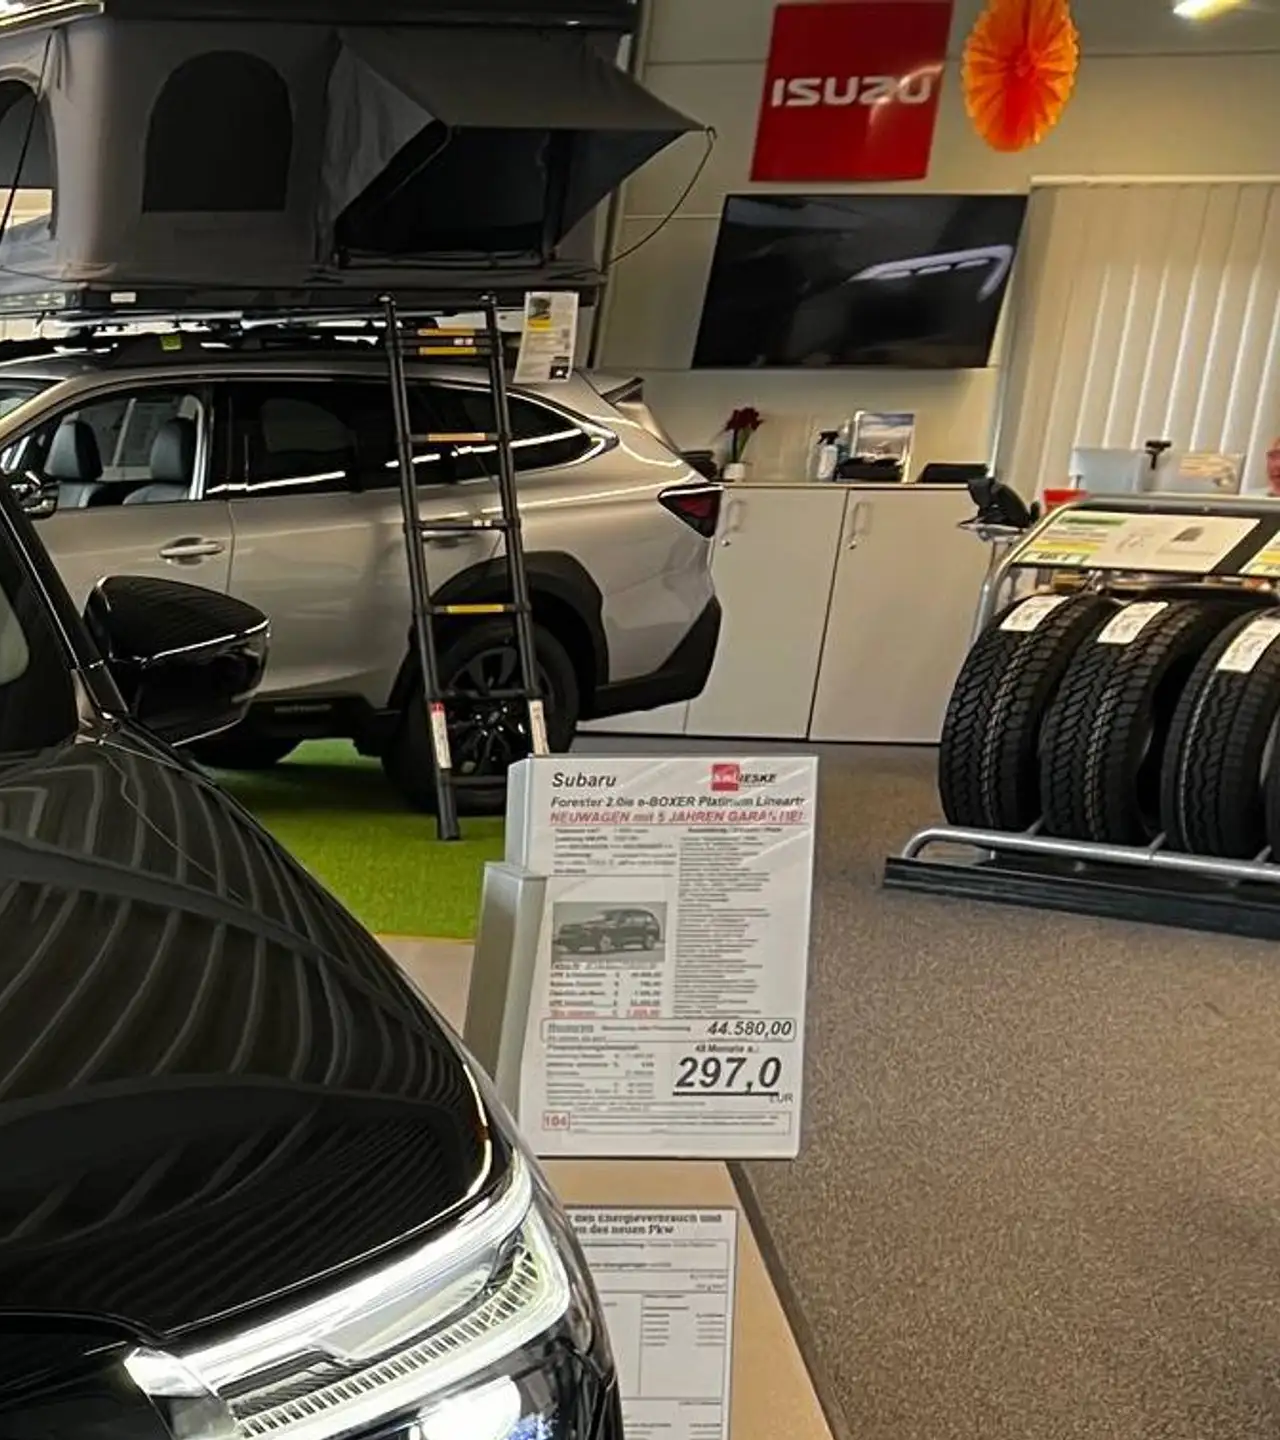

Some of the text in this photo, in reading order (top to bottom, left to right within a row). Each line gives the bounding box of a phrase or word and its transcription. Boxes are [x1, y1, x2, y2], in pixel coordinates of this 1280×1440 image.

[772, 76, 931, 107] ISUZU
[552, 772, 617, 788] Subaru
[551, 796, 602, 807] Forester
[638, 796, 695, 807] e-BOXER
[550, 810, 630, 823] NEUWAGEN
[668, 810, 725, 822] JAHREN
[707, 1021, 792, 1037] 44.580,00
[674, 1057, 782, 1093] 297,0
